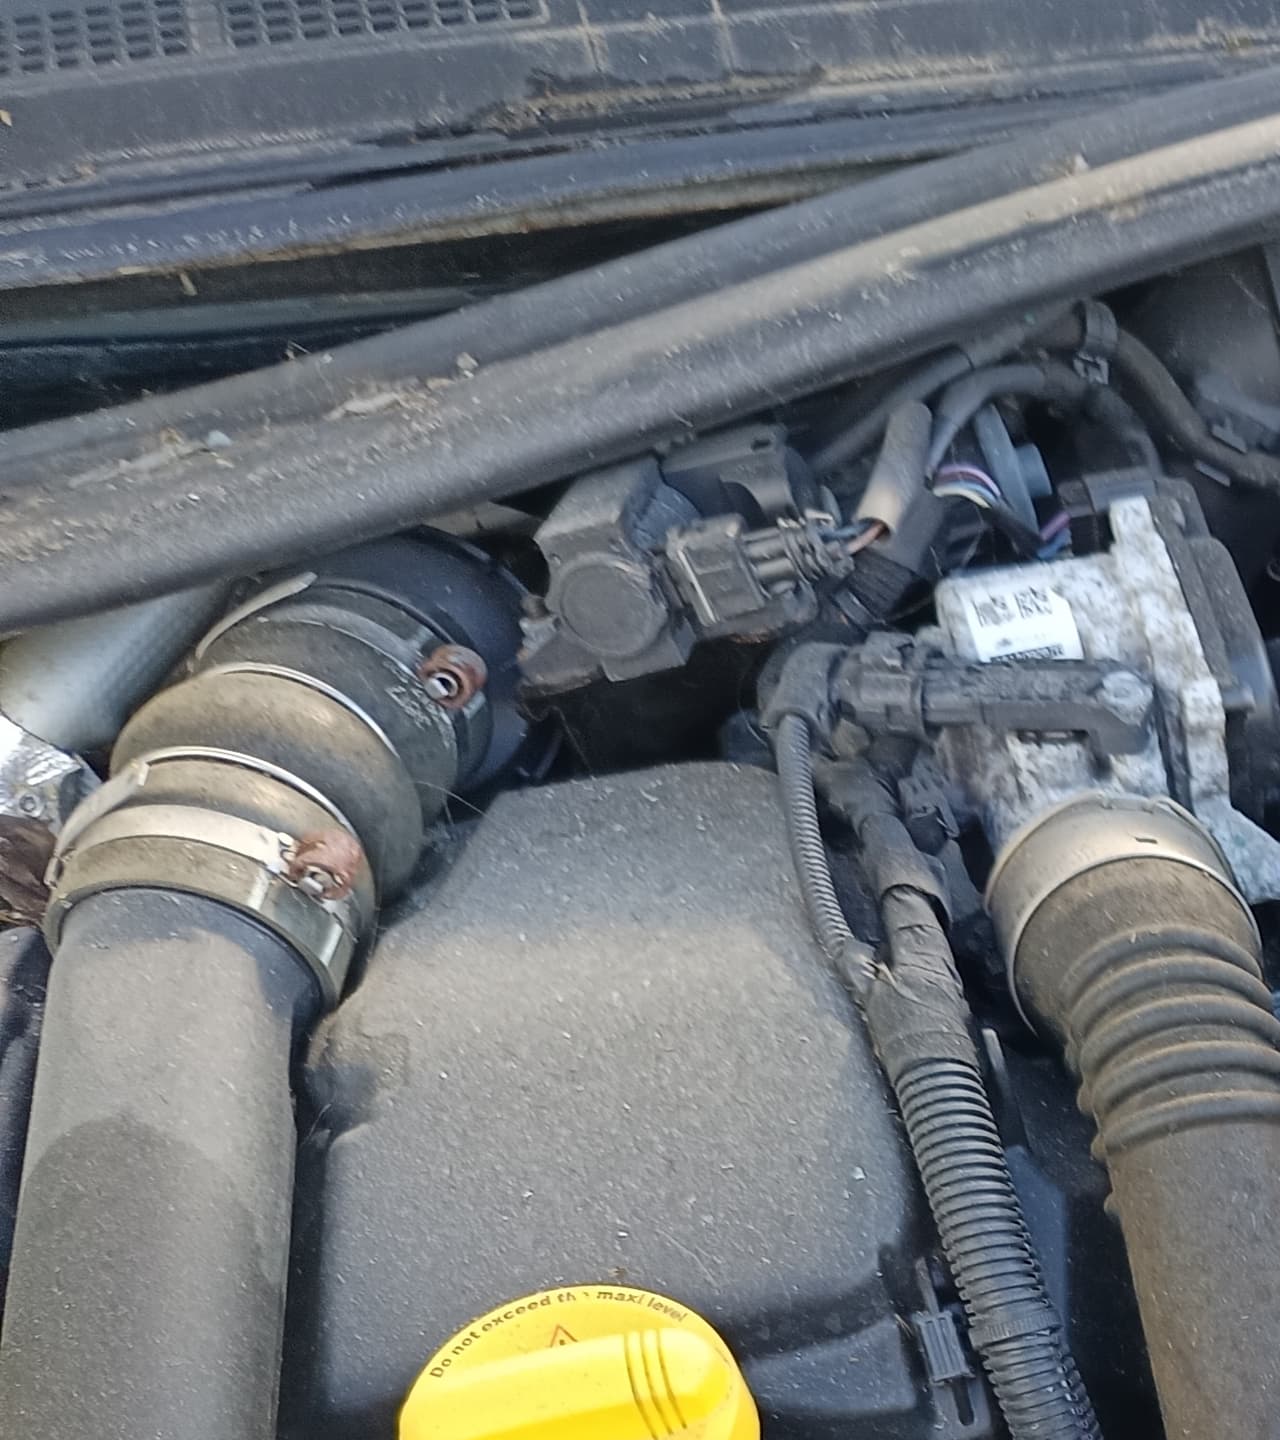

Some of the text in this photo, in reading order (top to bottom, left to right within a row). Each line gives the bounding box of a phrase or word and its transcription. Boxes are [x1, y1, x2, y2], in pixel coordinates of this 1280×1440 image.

[429, 1357, 452, 1378] Do
[451, 1331, 481, 1355] not
[481, 1295, 551, 1332] exceed
[596, 1291, 645, 1305] maxi
[646, 1297, 688, 1322] level
